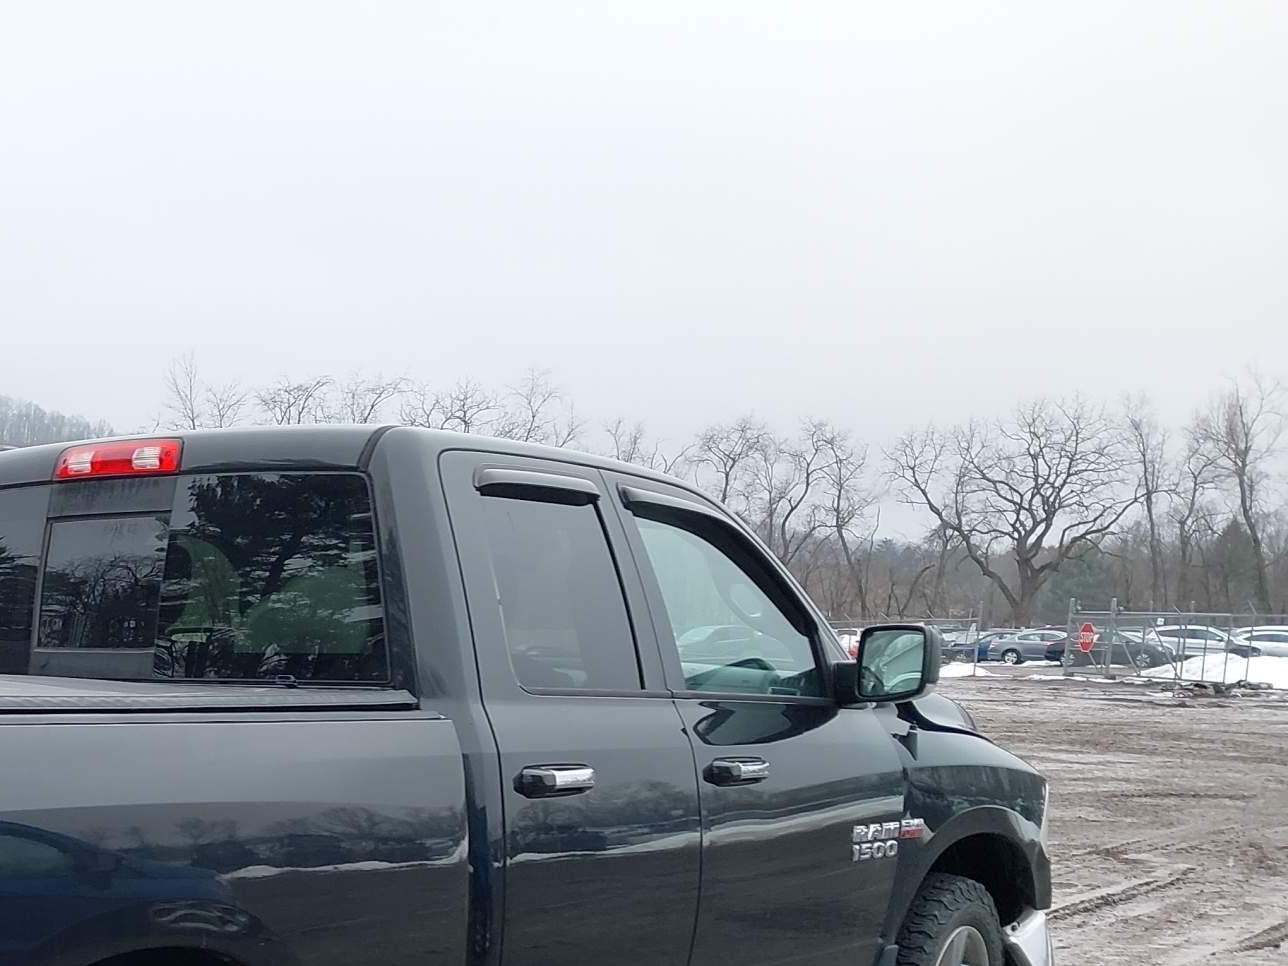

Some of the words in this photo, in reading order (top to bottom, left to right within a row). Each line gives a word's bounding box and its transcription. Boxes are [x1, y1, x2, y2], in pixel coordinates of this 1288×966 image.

[1080, 632, 1094, 643] STOP
[853, 822, 900, 842] RAM
[852, 840, 899, 862] 1500
